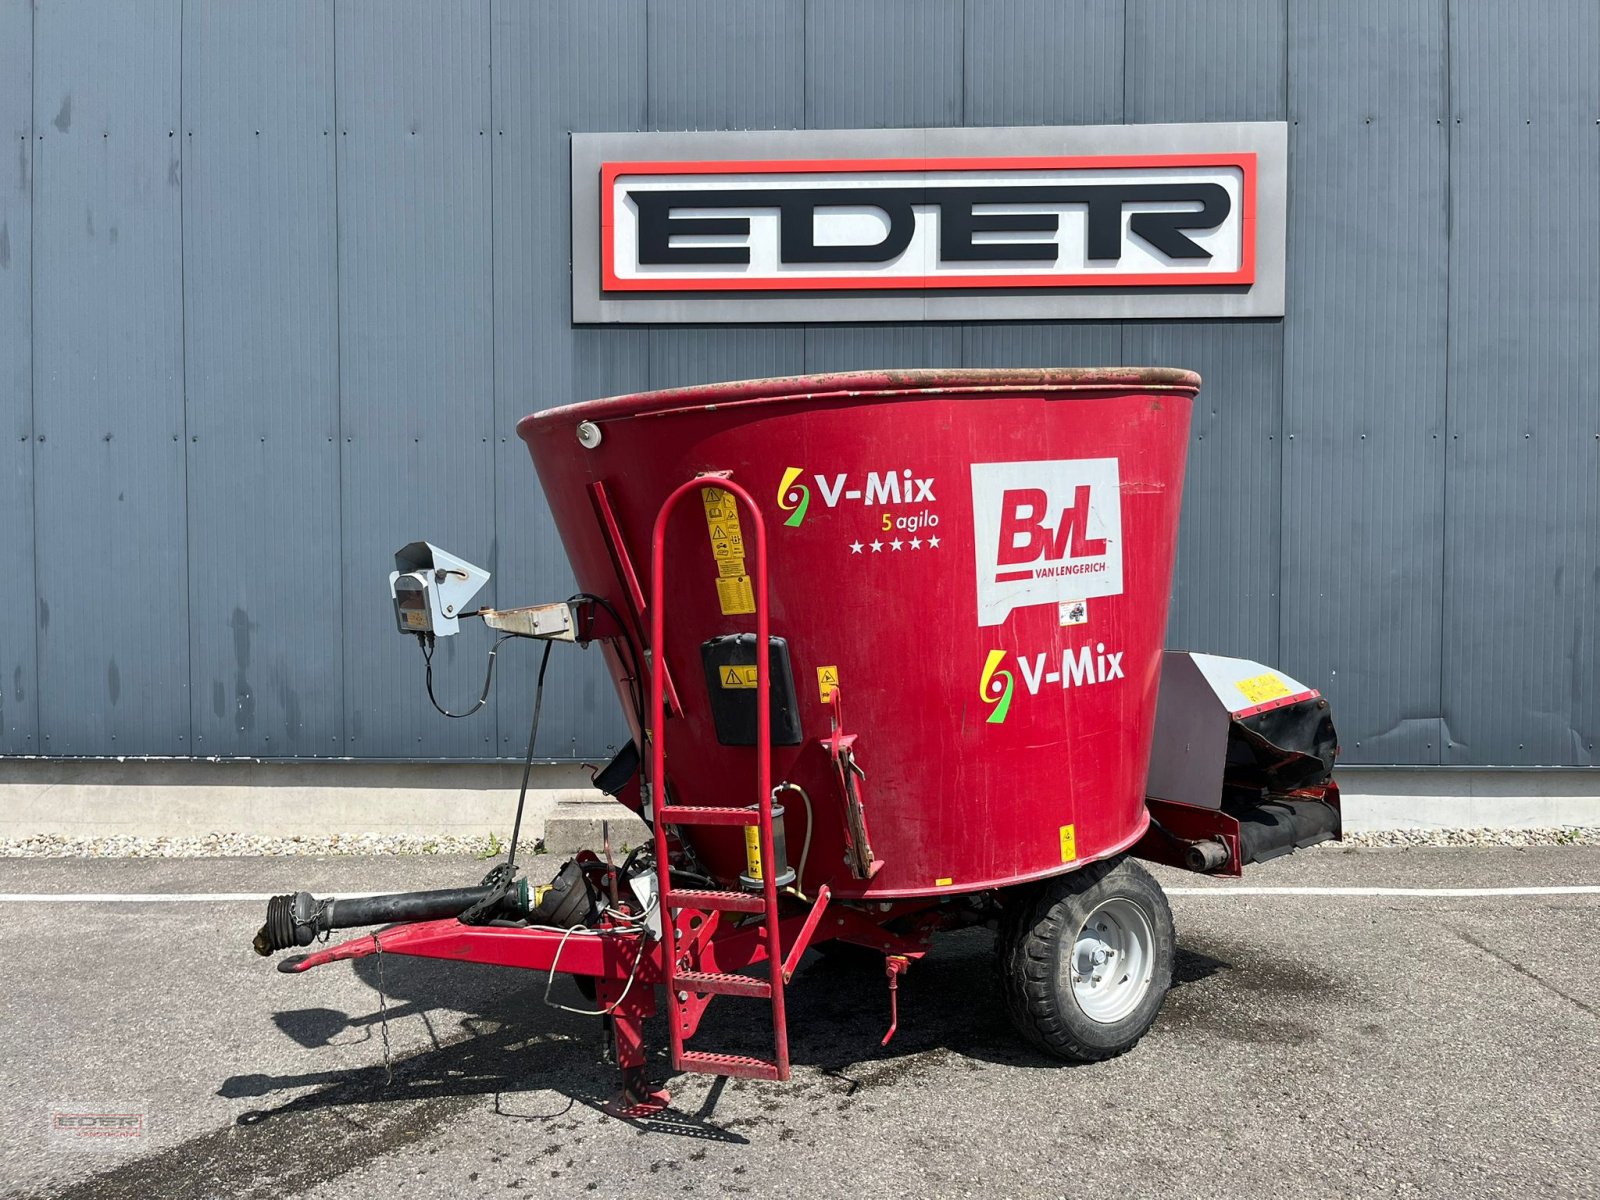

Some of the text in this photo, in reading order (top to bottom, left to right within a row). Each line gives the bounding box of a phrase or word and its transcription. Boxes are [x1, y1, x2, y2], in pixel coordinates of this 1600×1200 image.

[626, 182, 1232, 265] EDER
[814, 468, 937, 507] V-Mix
[881, 509, 939, 533] 5 agilo
[1016, 642, 1125, 695] V-Mix
